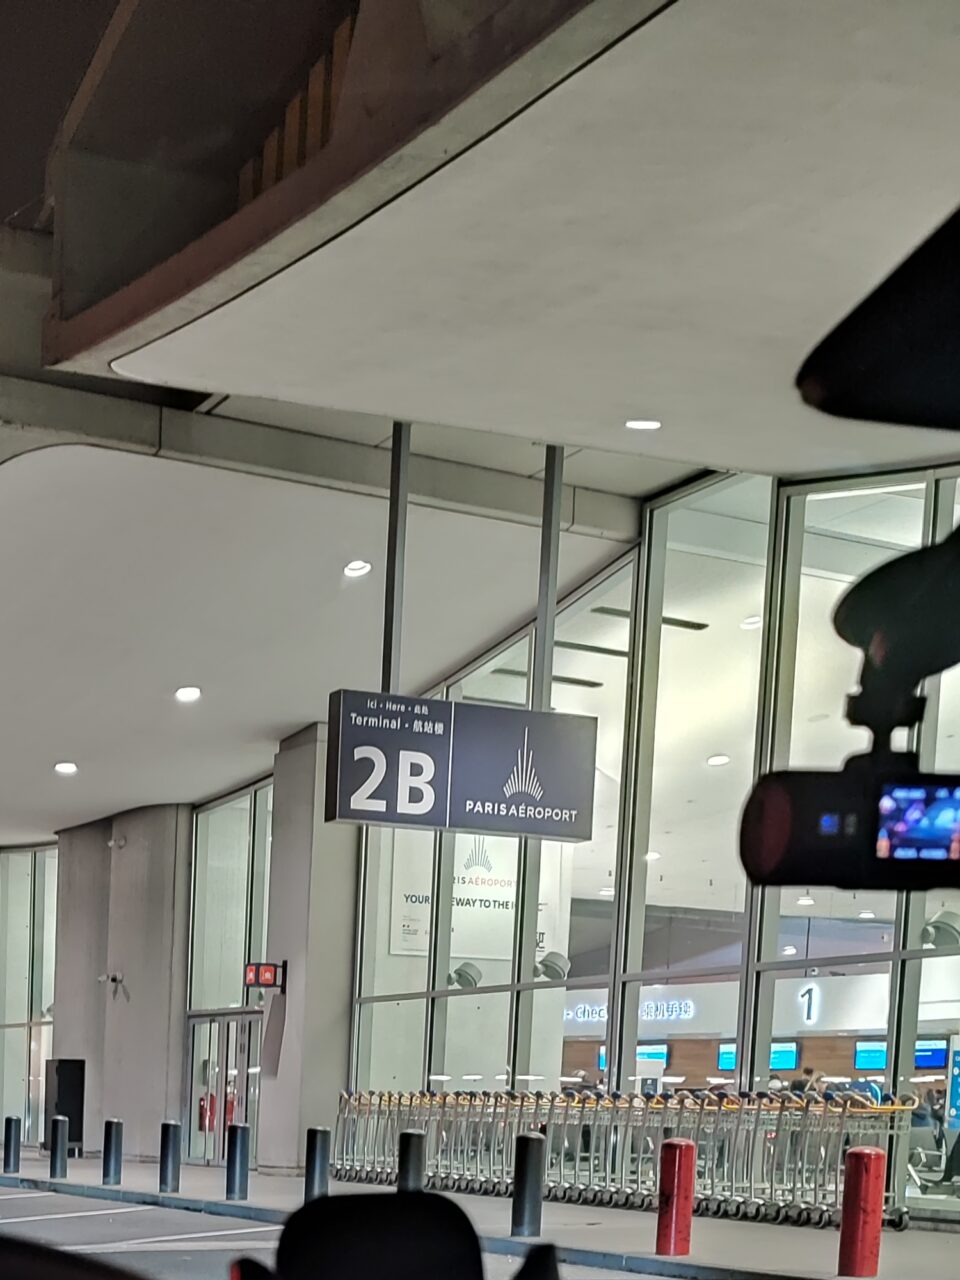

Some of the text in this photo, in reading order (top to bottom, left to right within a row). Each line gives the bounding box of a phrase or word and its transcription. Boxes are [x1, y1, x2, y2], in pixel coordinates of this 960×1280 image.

[367, 698, 406, 713] Ici Here
[350, 712, 401, 730] Terminal
[350, 745, 436, 815] 2B
[403, 893, 431, 905] YOUR
[479, 899, 491, 909] TO
[492, 899, 510, 910] THE
[800, 983, 816, 1021] 1
